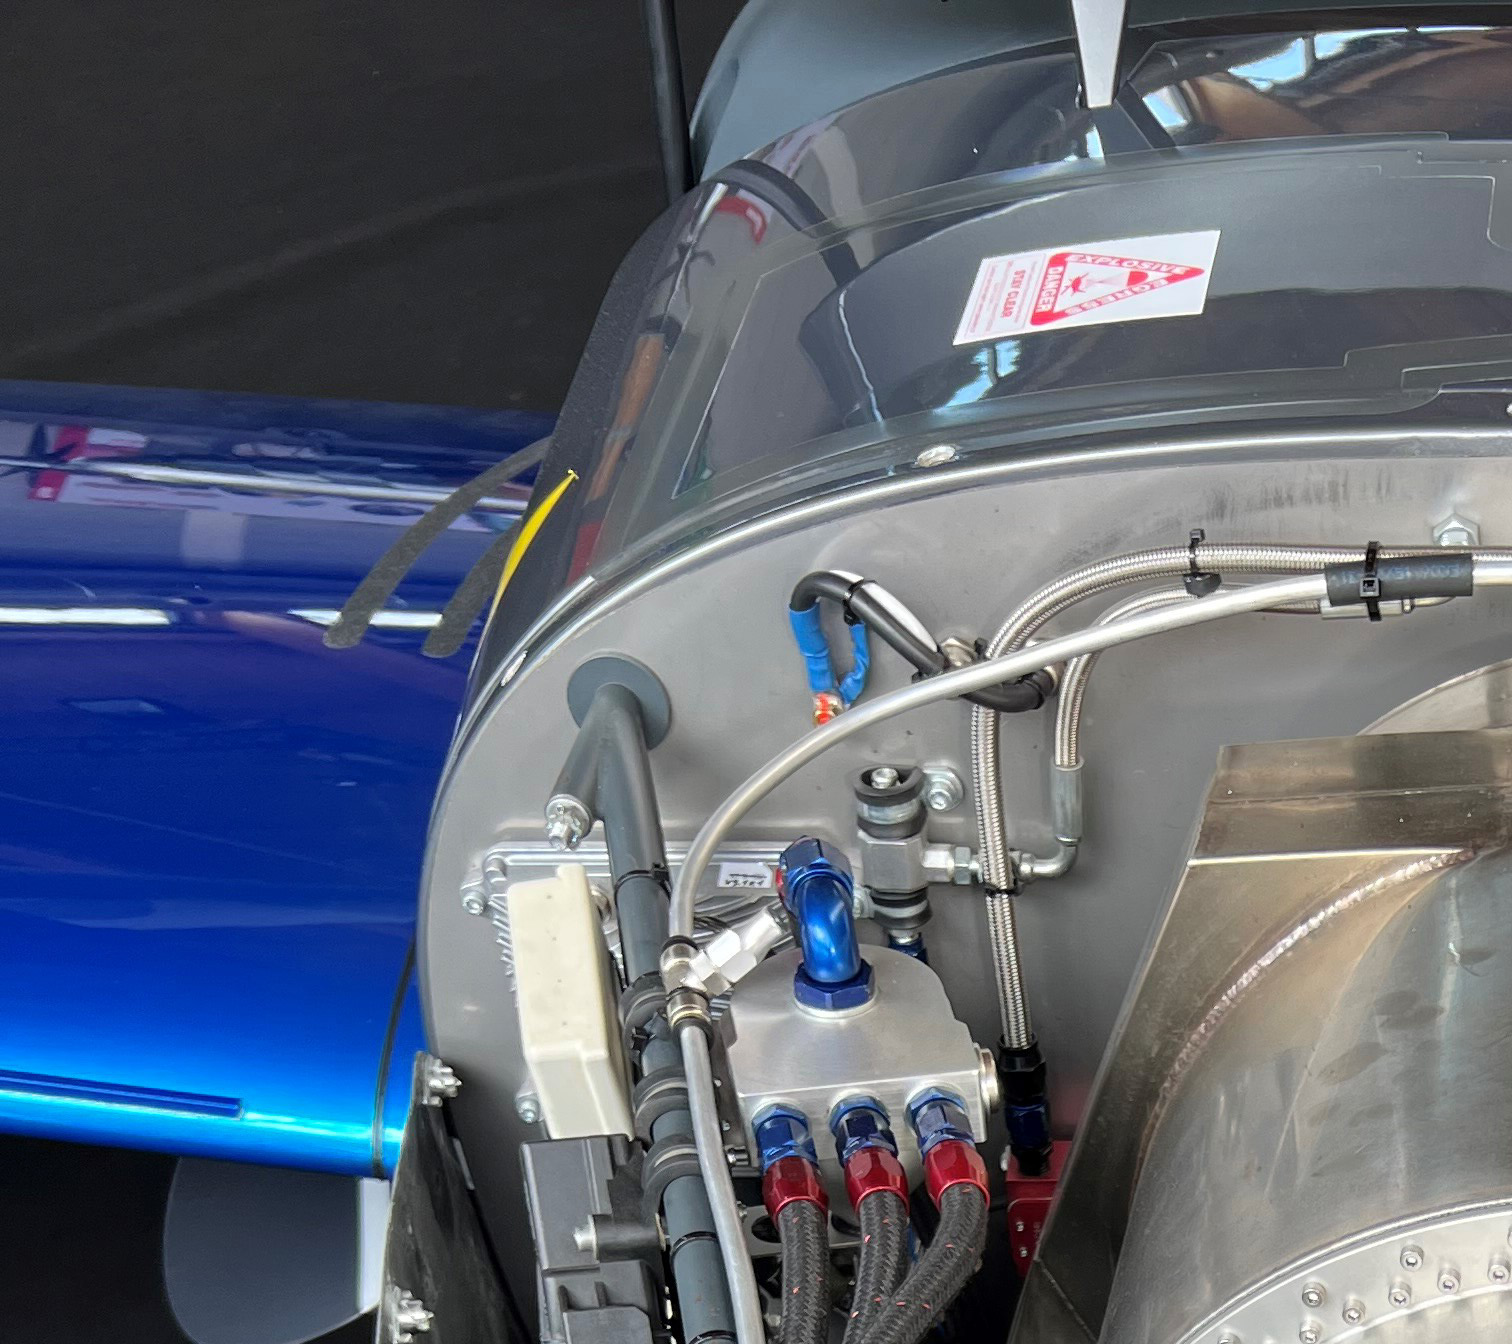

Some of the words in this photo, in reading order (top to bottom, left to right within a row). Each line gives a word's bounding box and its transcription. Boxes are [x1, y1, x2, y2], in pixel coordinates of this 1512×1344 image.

[1066, 254, 1190, 274] EXPLOSIVE
[1002, 291, 1020, 318] CLEAR
[1036, 266, 1064, 312] DANGER
[1065, 278, 1168, 315] EGRESS
